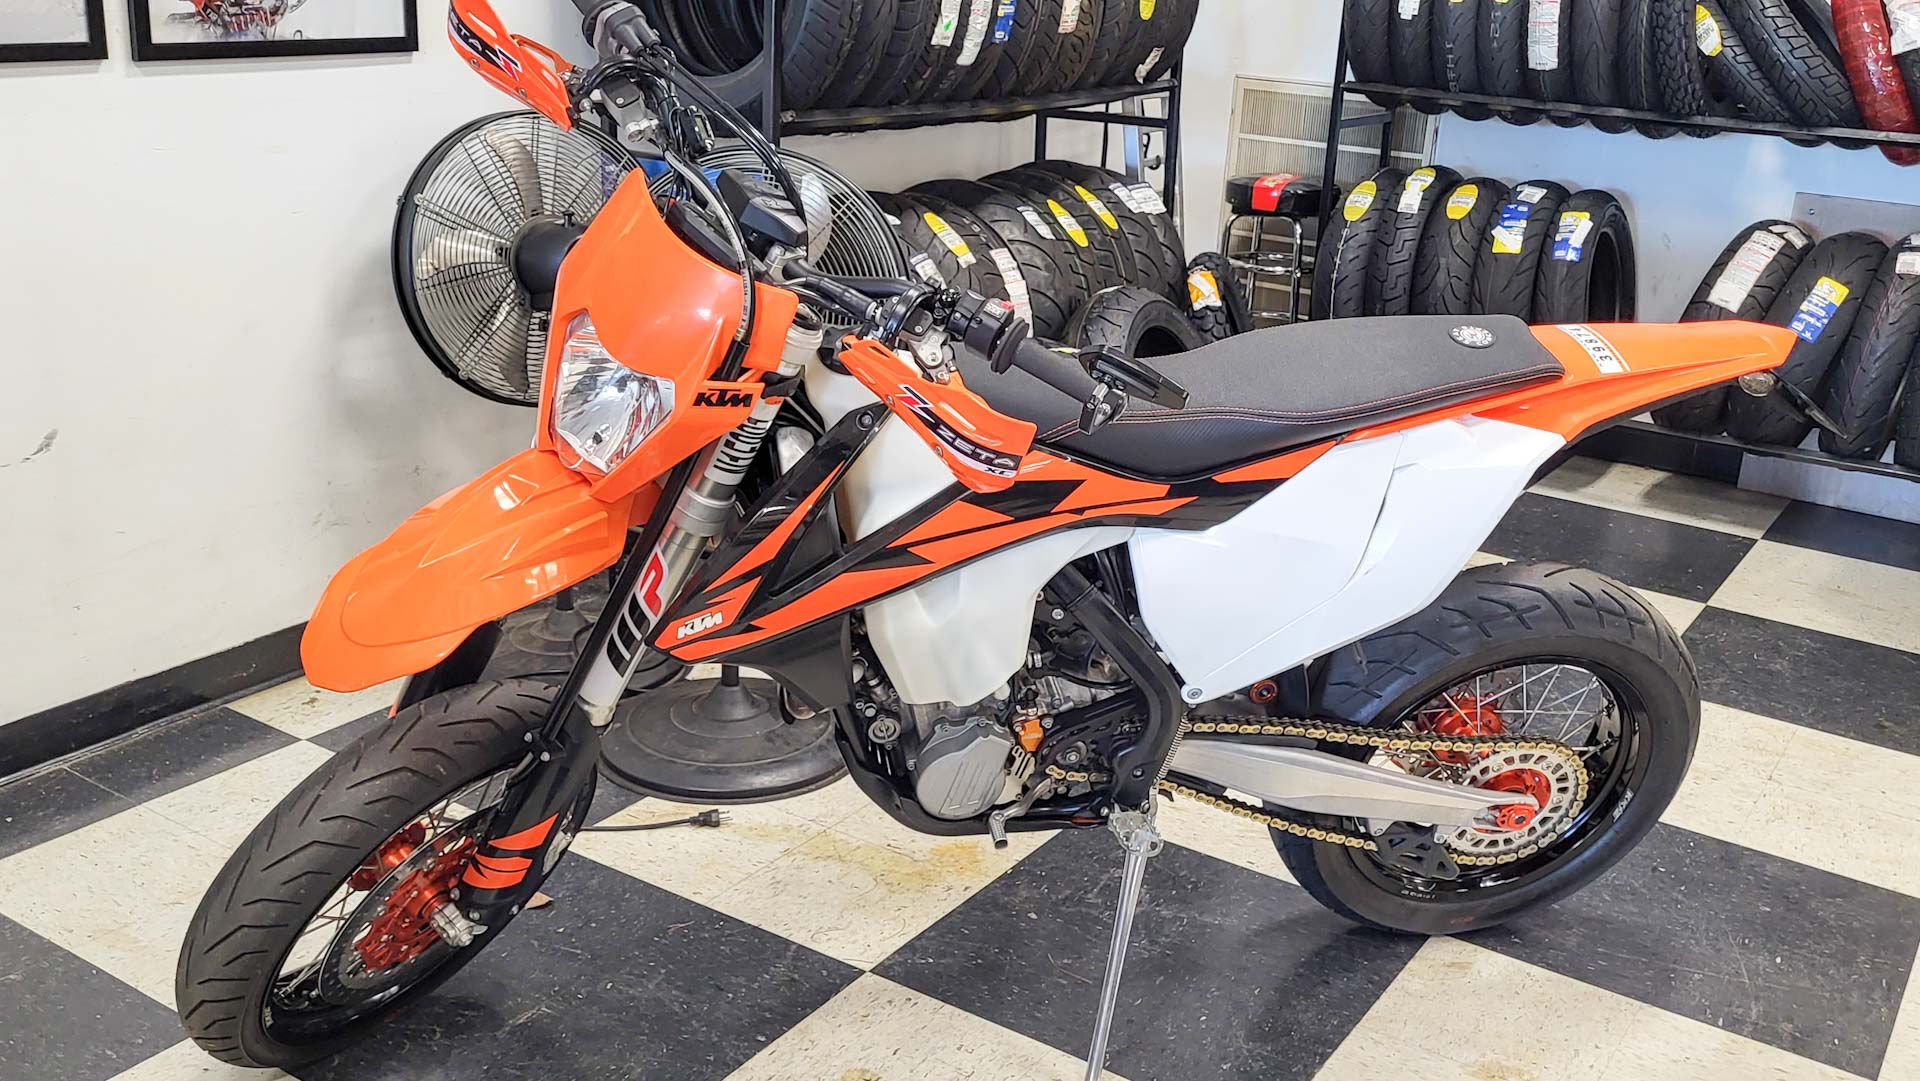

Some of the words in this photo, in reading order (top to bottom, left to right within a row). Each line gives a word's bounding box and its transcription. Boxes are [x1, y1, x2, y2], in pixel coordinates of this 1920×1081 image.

[692, 388, 754, 408] KTM
[936, 424, 1017, 468] ZETA
[676, 611, 724, 640] KTM
